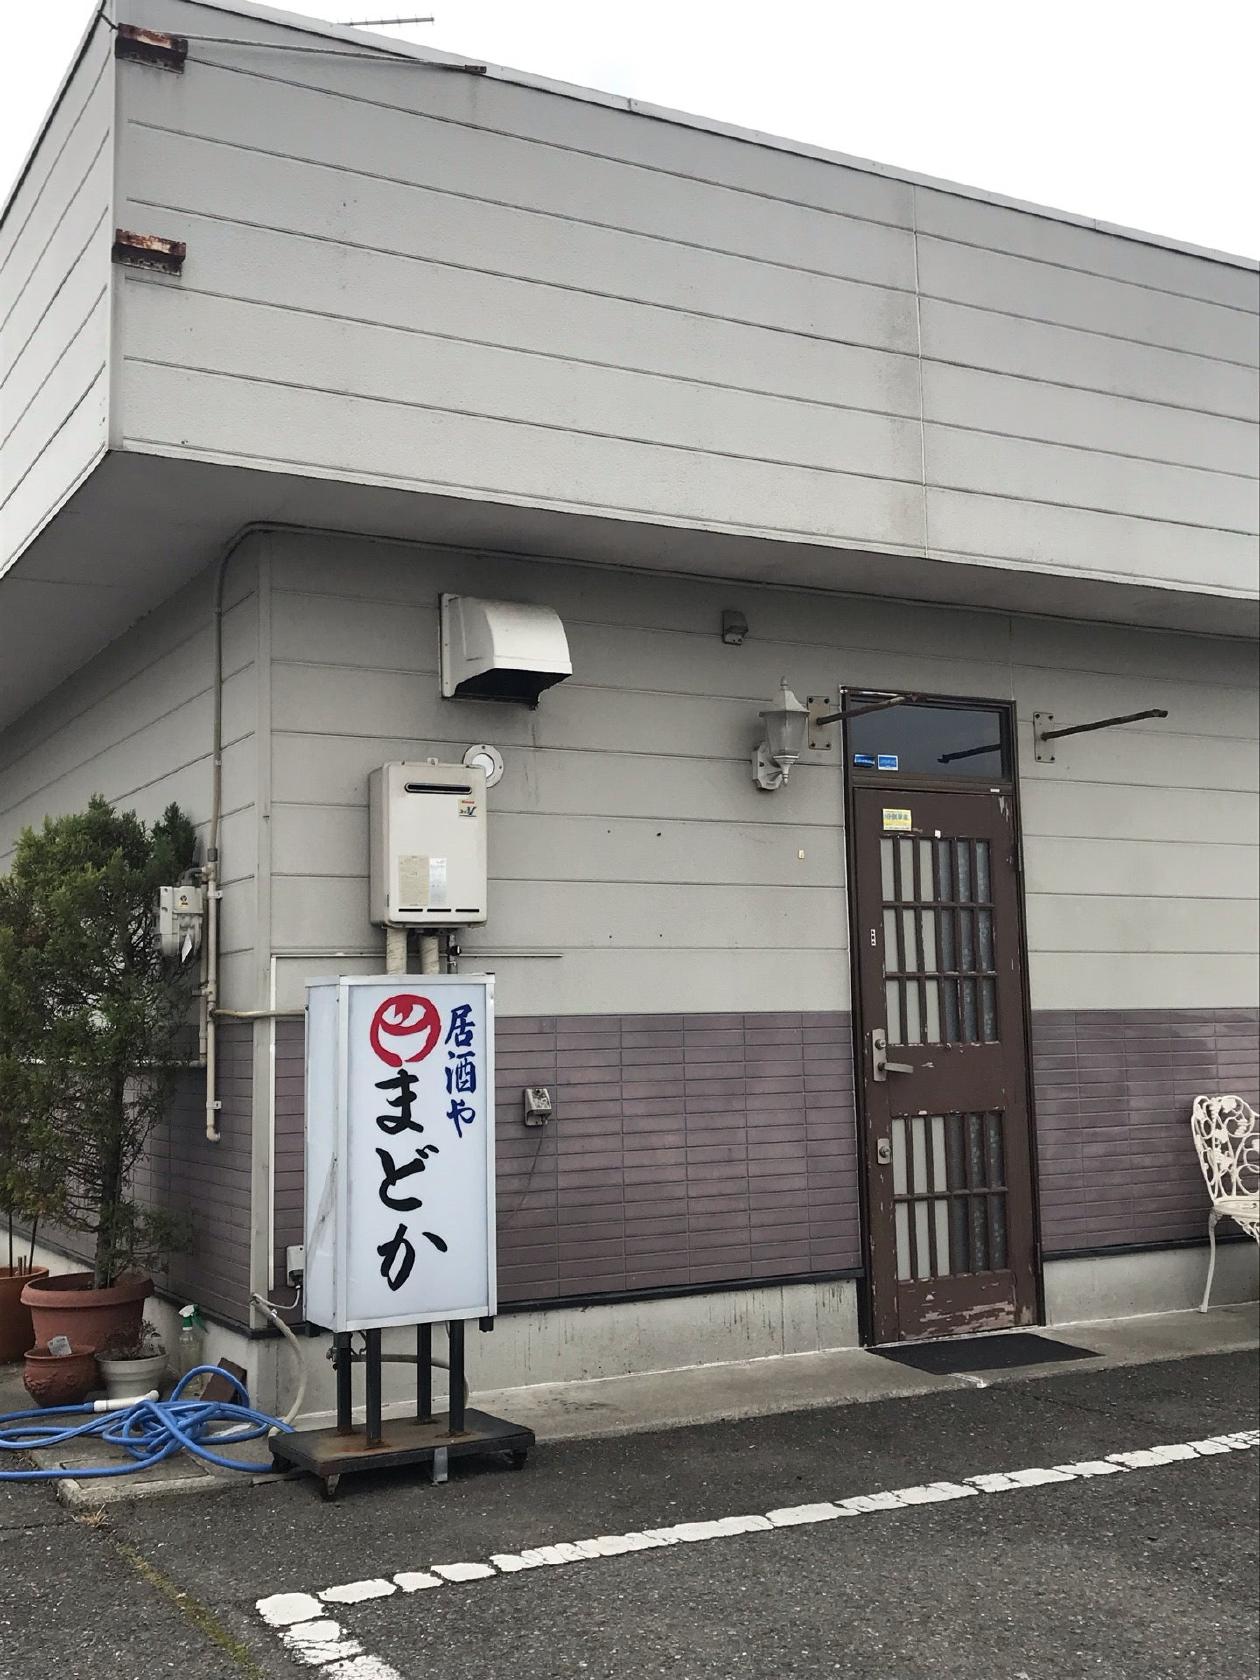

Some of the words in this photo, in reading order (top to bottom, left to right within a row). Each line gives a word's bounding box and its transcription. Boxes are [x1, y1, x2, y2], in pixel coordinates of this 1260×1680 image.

[444, 1003, 477, 1139] 居酒や
[374, 1068, 448, 1292] まどか
